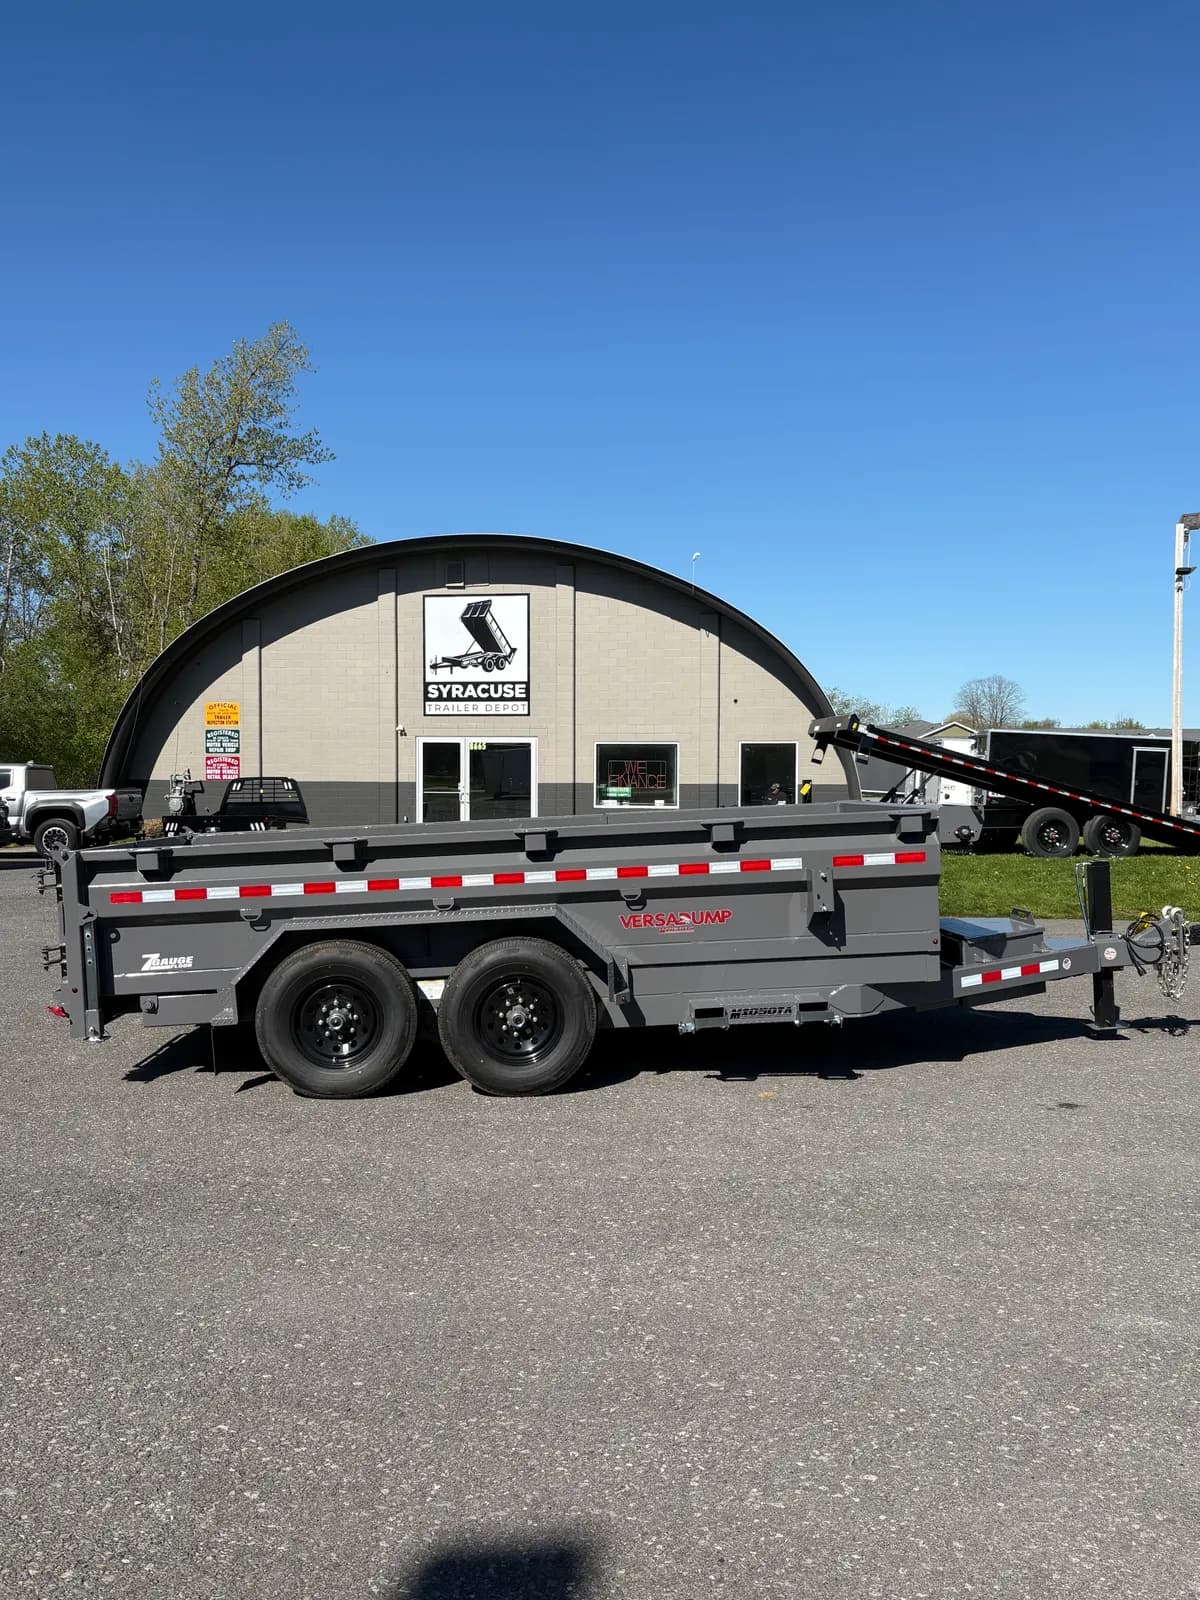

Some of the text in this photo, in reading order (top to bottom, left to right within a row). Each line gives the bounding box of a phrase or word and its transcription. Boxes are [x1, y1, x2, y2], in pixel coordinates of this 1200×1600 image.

[427, 684, 527, 698] SYRACUSE
[208, 702, 238, 711] OFFICIAL
[427, 704, 527, 712] TRAILER DEPOT
[207, 729, 239, 738] REGISTERED
[207, 757, 239, 766] REGISTERED
[623, 760, 648, 775] WE
[608, 774, 667, 789] FINANCE
[619, 909, 732, 929] VERSADUMP
[141, 953, 194, 971] 7 GAUGE
